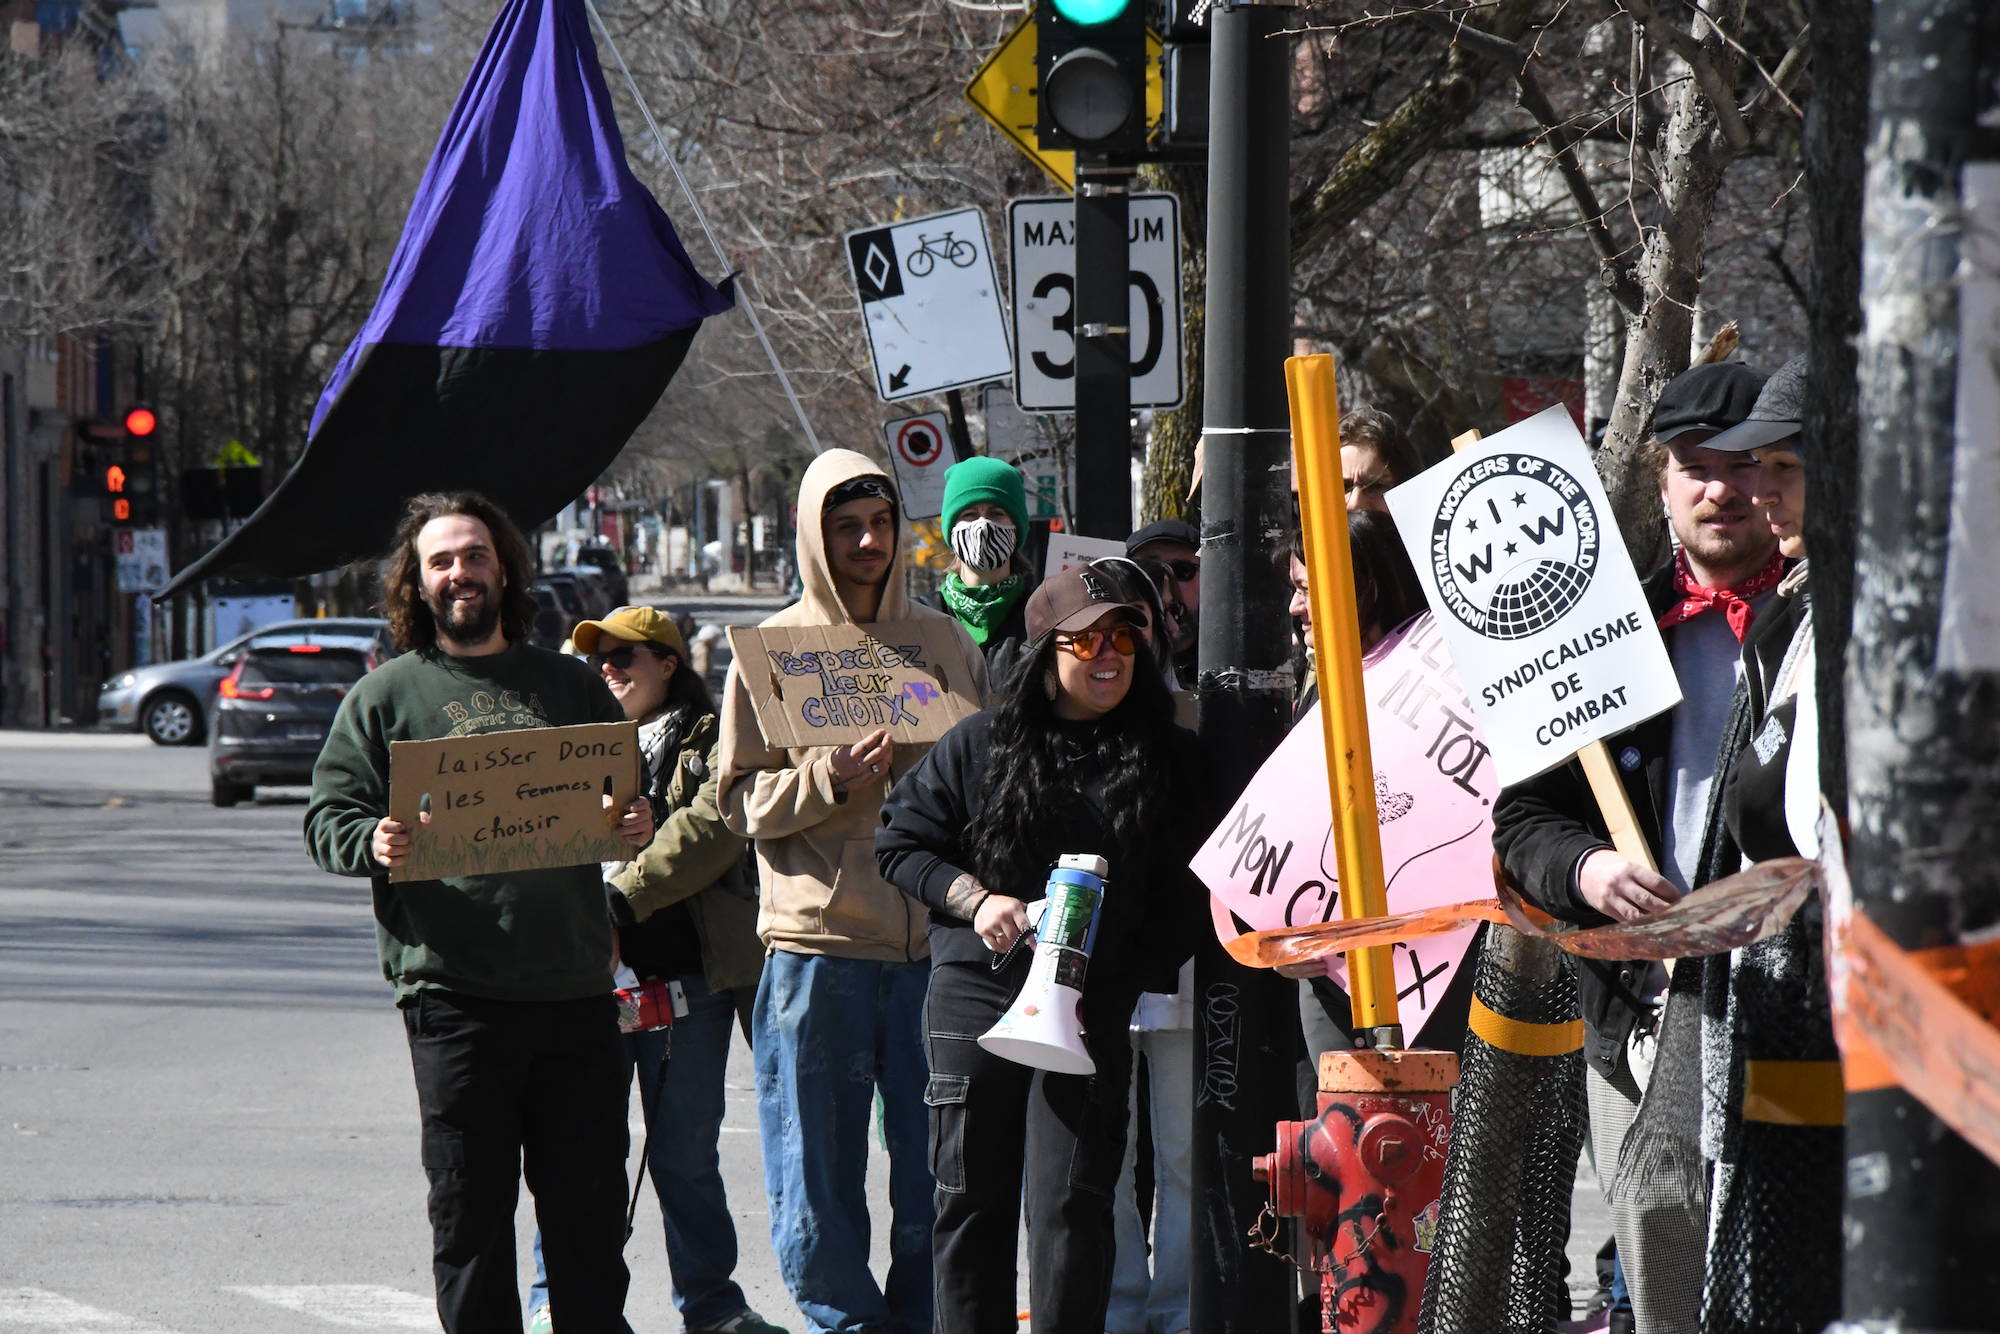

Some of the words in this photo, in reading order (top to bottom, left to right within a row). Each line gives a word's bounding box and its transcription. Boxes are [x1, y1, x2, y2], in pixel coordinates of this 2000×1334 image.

[1024, 217, 1164, 247] MAUM
[1031, 270, 1164, 380] 30
[1516, 456, 1545, 475] OF
[1438, 456, 1509, 521] WORKERS
[1547, 469, 1580, 500] THE
[1486, 498, 1502, 525] I
[1454, 542, 1492, 584] W
[1519, 505, 1565, 546] W
[1573, 499, 1596, 569] WORLD
[1434, 529, 1486, 630] INDUSTRIAL
[1481, 611, 1643, 707] SYNDICALISME
[1550, 672, 1583, 702] DE
[442, 690, 548, 725] BOCA
[801, 694, 920, 728] CHOIX
[1536, 685, 1628, 746] COMBAT
[559, 740, 624, 763] Donc
[446, 790, 487, 811] les
[515, 779, 592, 801] femmes
[473, 814, 561, 843] choisir
[1217, 802, 1294, 897] MON
